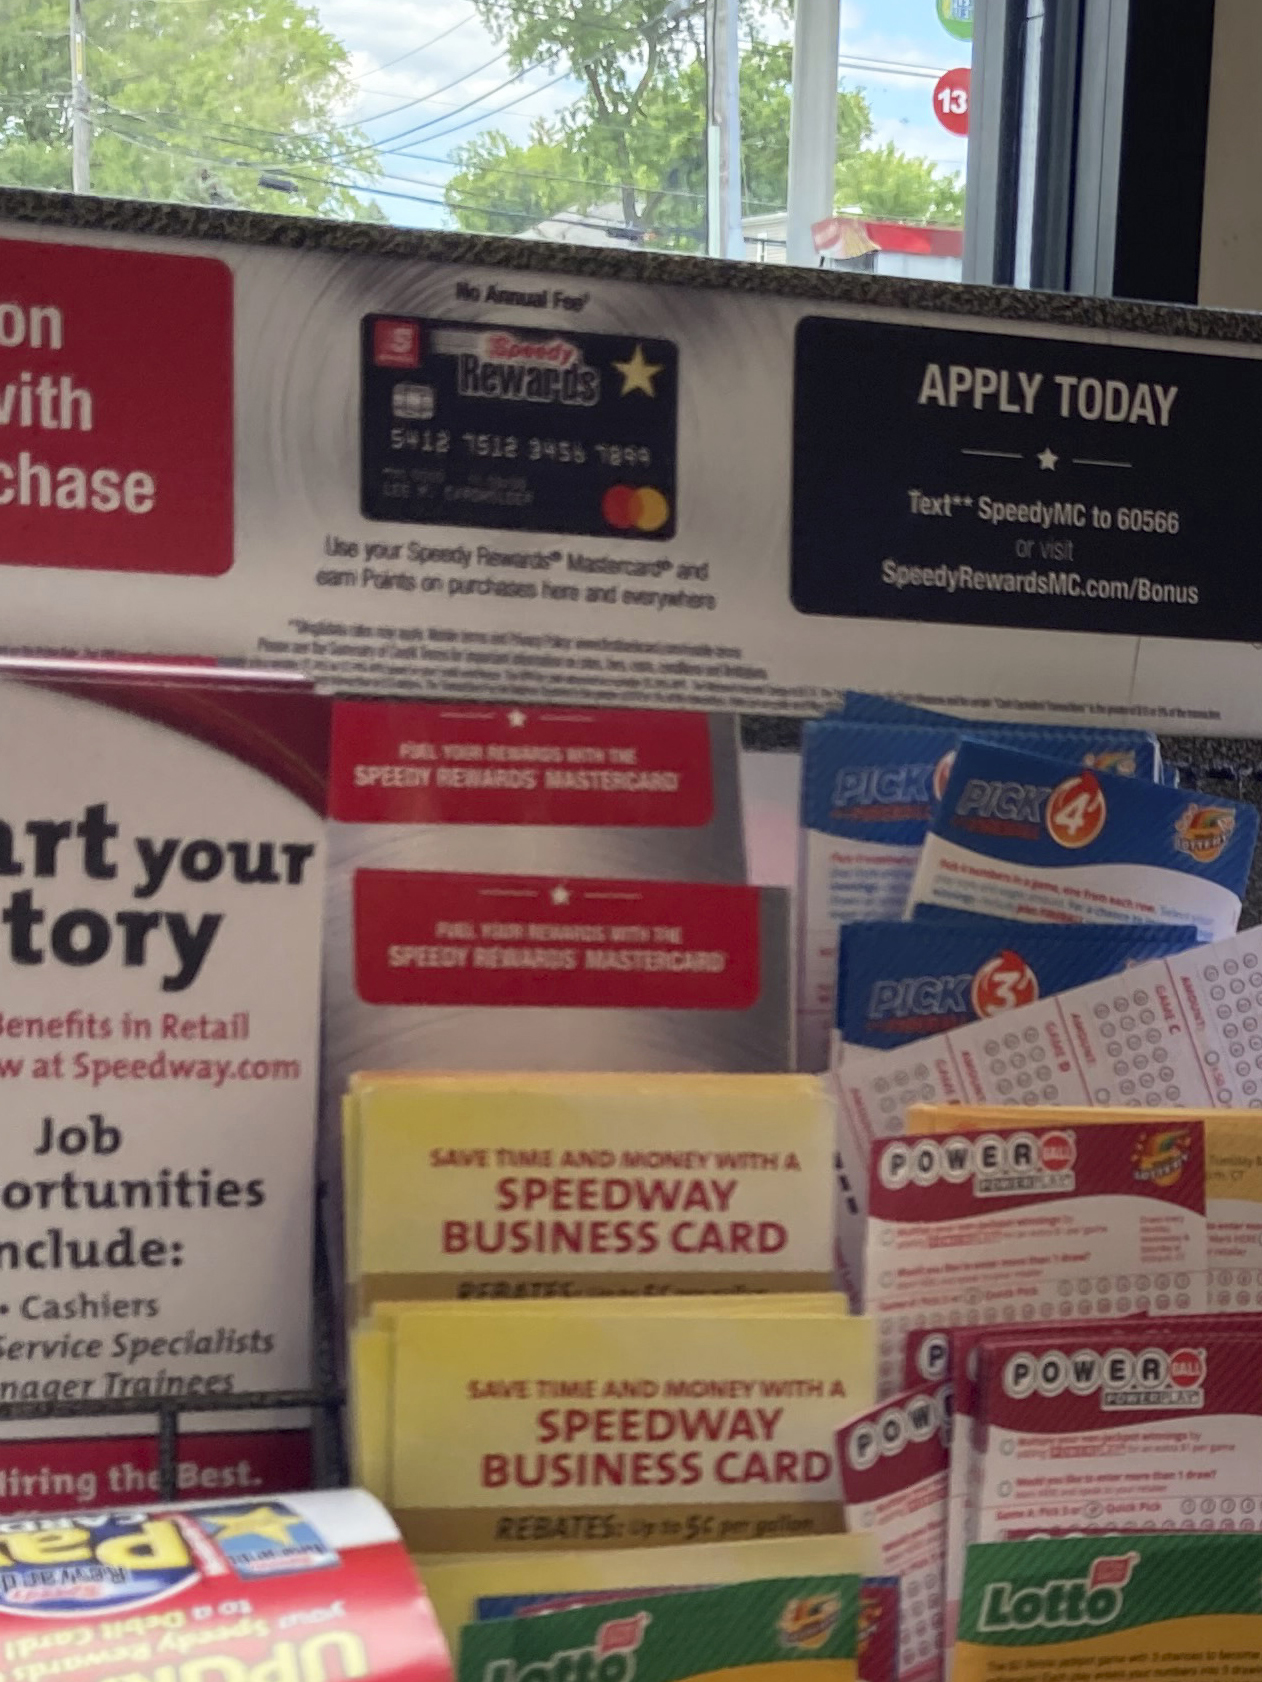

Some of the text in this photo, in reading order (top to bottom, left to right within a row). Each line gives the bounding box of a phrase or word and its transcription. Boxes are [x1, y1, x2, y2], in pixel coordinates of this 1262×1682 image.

[937, 87, 968, 115] 13
[456, 281, 480, 301] No
[485, 284, 548, 308] Annual
[0, 303, 62, 350] on
[487, 334, 577, 365] Speedy
[460, 354, 599, 406] Rewards
[917, 363, 1179, 428] APPLY TODAY
[390, 428, 450, 452] 5412
[462, 433, 518, 458] 7512
[977, 495, 1087, 530] SpeedyMC
[1091, 505, 1112, 530] to
[1116, 507, 1181, 535] 60566
[325, 534, 358, 558] Use
[364, 542, 404, 561] your
[407, 540, 472, 568] Speedy
[675, 562, 709, 582] and
[1015, 538, 1075, 562] or visit
[315, 568, 717, 612] earn Points on purchases here and everywhere
[881, 557, 1200, 605] SpeedyRewardsMC.com/Bonus
[399, 742, 639, 765] FUEL YOUR REWARDS WITH THE
[353, 764, 680, 793] SPEEDY REWARDS MASTERCARD
[833, 763, 930, 805] PICK
[955, 778, 1052, 825] PICK
[1054, 795, 1091, 836] 4
[132, 836, 317, 900] your
[1, 888, 227, 993] tory
[434, 921, 684, 946] FUEL YOUR REWARDS WITH THE
[387, 945, 727, 974] SPEEDY REWARDS MASTERCARD
[867, 970, 1023, 1020] PICK 3
[121, 1012, 152, 1040] in
[161, 1012, 251, 1041] Retail
[31, 1052, 65, 1080] at
[72, 1050, 301, 1088] Speedway.com
[33, 1113, 123, 1157] Job
[428, 1148, 803, 1171] SAVE TIME AND MONEY WITH A
[888, 1139, 1034, 1178] POWER
[495, 1176, 739, 1212] SPEEDWAY
[440, 1219, 791, 1255] BUSINESS CARD
[20, 1291, 160, 1321] Cashiers
[110, 1326, 275, 1365] Specialists
[104, 1368, 236, 1398] Trainees
[466, 1379, 847, 1400] SAVE TIME AND MONEY WITH A
[1012, 1356, 1164, 1387] POWER
[536, 1406, 785, 1444] SPEEDWAY
[109, 1463, 160, 1493] the
[175, 1460, 263, 1490] Best.
[480, 1448, 834, 1488] BUSINESS CARD
[495, 1515, 624, 1541] REBATES:
[979, 1580, 1123, 1632] Lotto
[2, 1596, 252, 1661] to a Debit Card!
[11, 1599, 347, 1682] your Speedy Rewards
[483, 1646, 636, 1682] Lotto
